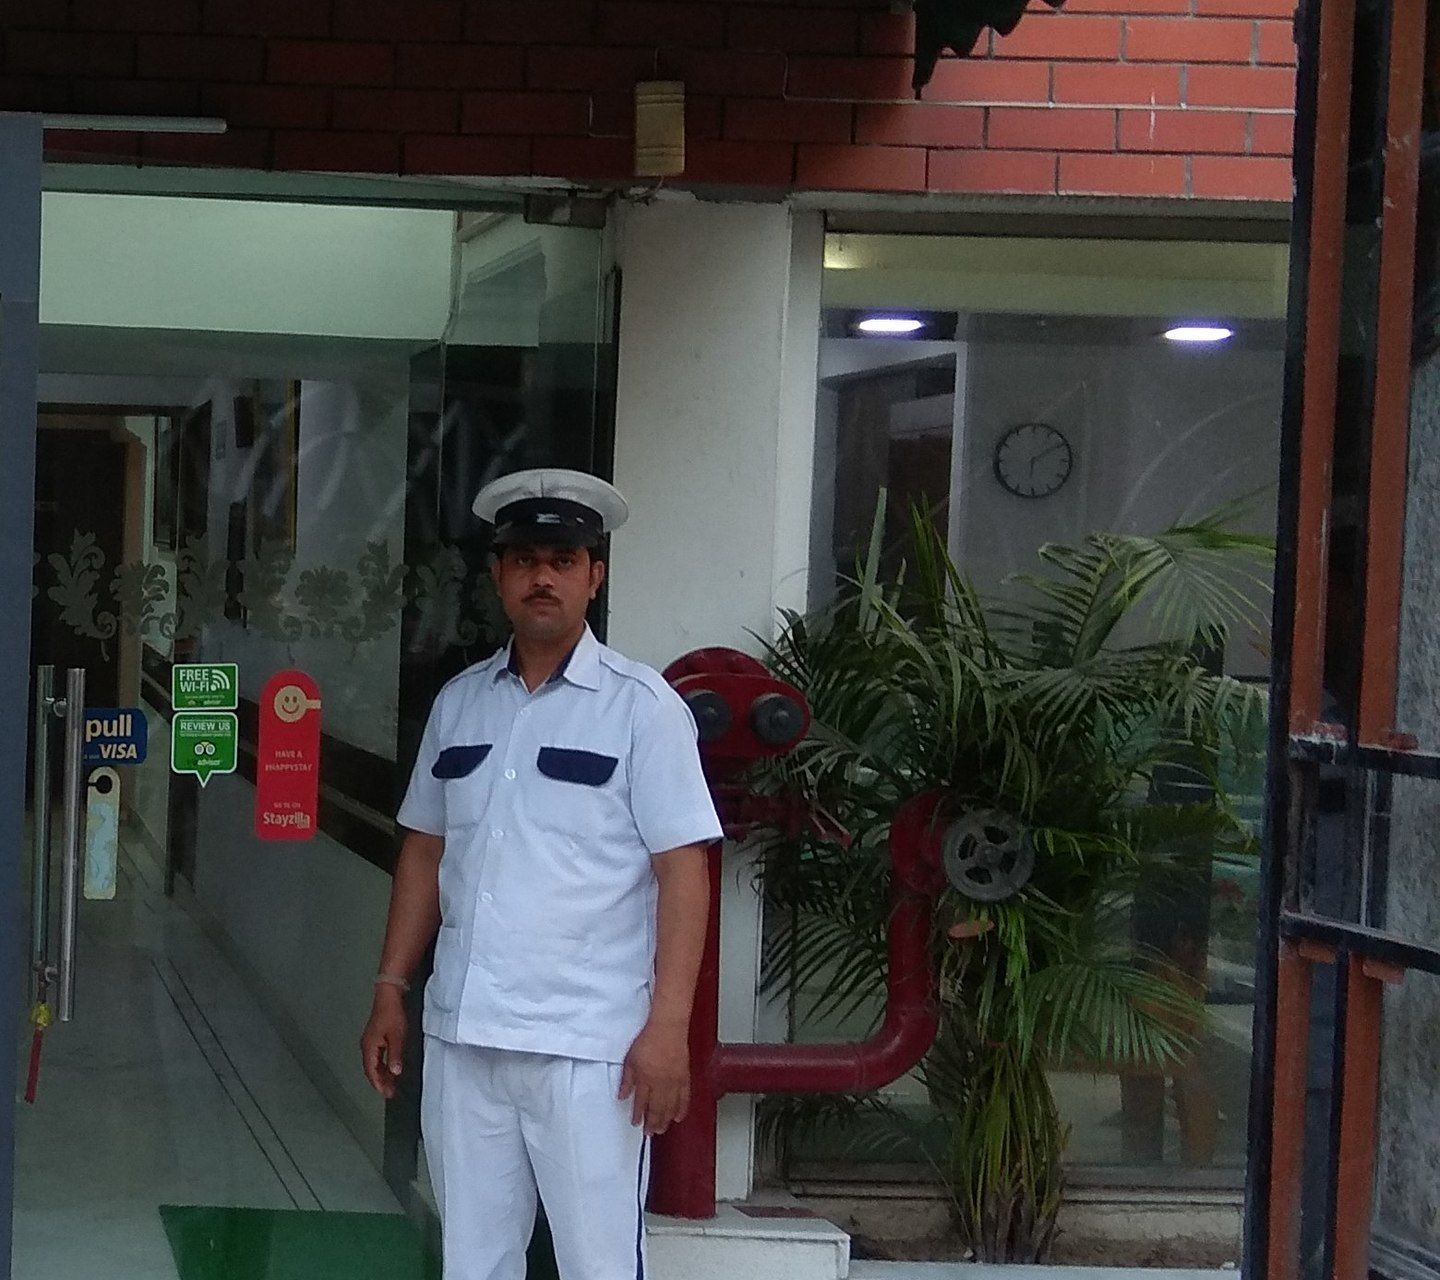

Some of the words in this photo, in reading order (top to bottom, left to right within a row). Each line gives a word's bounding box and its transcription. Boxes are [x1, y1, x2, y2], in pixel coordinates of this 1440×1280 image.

[179, 668, 210, 681] FREE
[180, 681, 210, 693] WI-FI
[85, 713, 132, 743] pull
[180, 721, 216, 731] REVIEW
[218, 721, 231, 731] US
[98, 743, 138, 759] VISA
[274, 750, 296, 758] HAVE
[296, 750, 303, 758] A
[263, 811, 311, 829] Stayzilla
